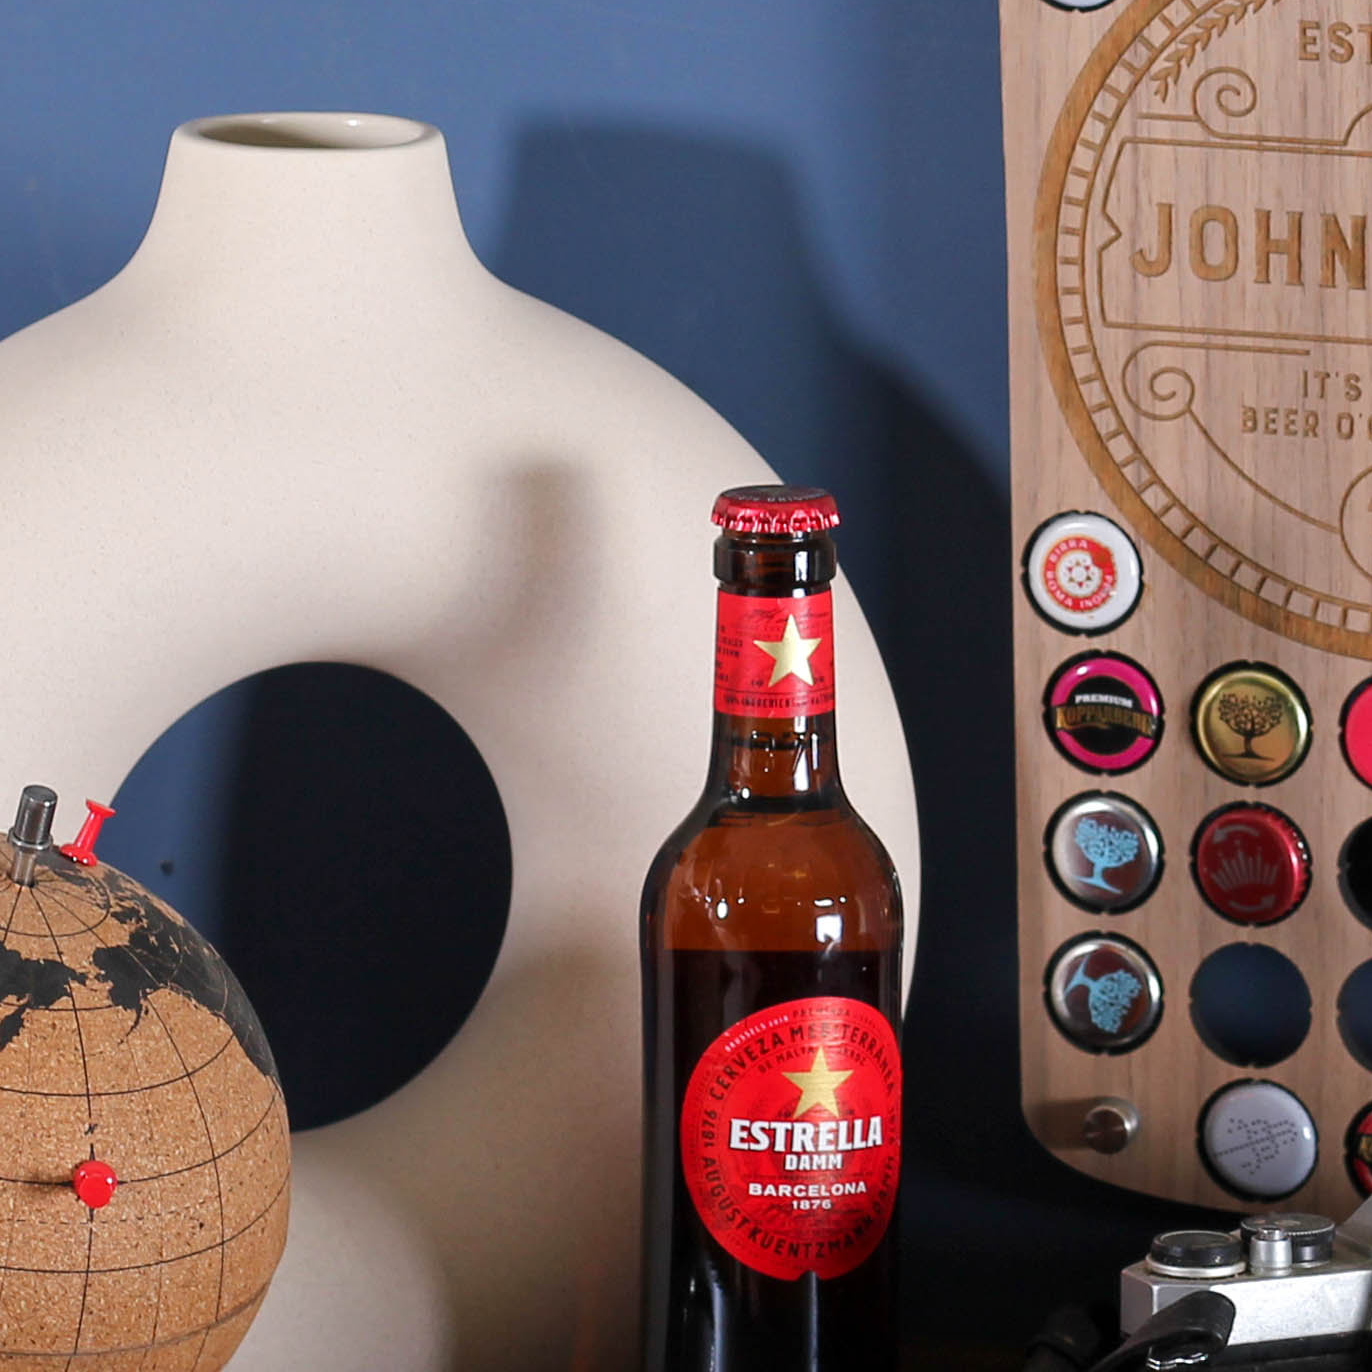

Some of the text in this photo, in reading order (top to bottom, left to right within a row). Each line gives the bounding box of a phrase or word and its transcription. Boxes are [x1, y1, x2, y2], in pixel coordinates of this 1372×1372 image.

[1302, 369, 1363, 403] IT'S
[1241, 404, 1320, 439] BEER
[1074, 693, 1133, 709] PREMIUM
[709, 1032, 785, 1101] CERVEZA
[730, 1116, 883, 1153] ESTRELLA
[784, 1153, 844, 1171] DAMM
[702, 1156, 751, 1230] AUGUST
[748, 1181, 867, 1198] BARCELONA
[791, 1198, 833, 1211] 1876
